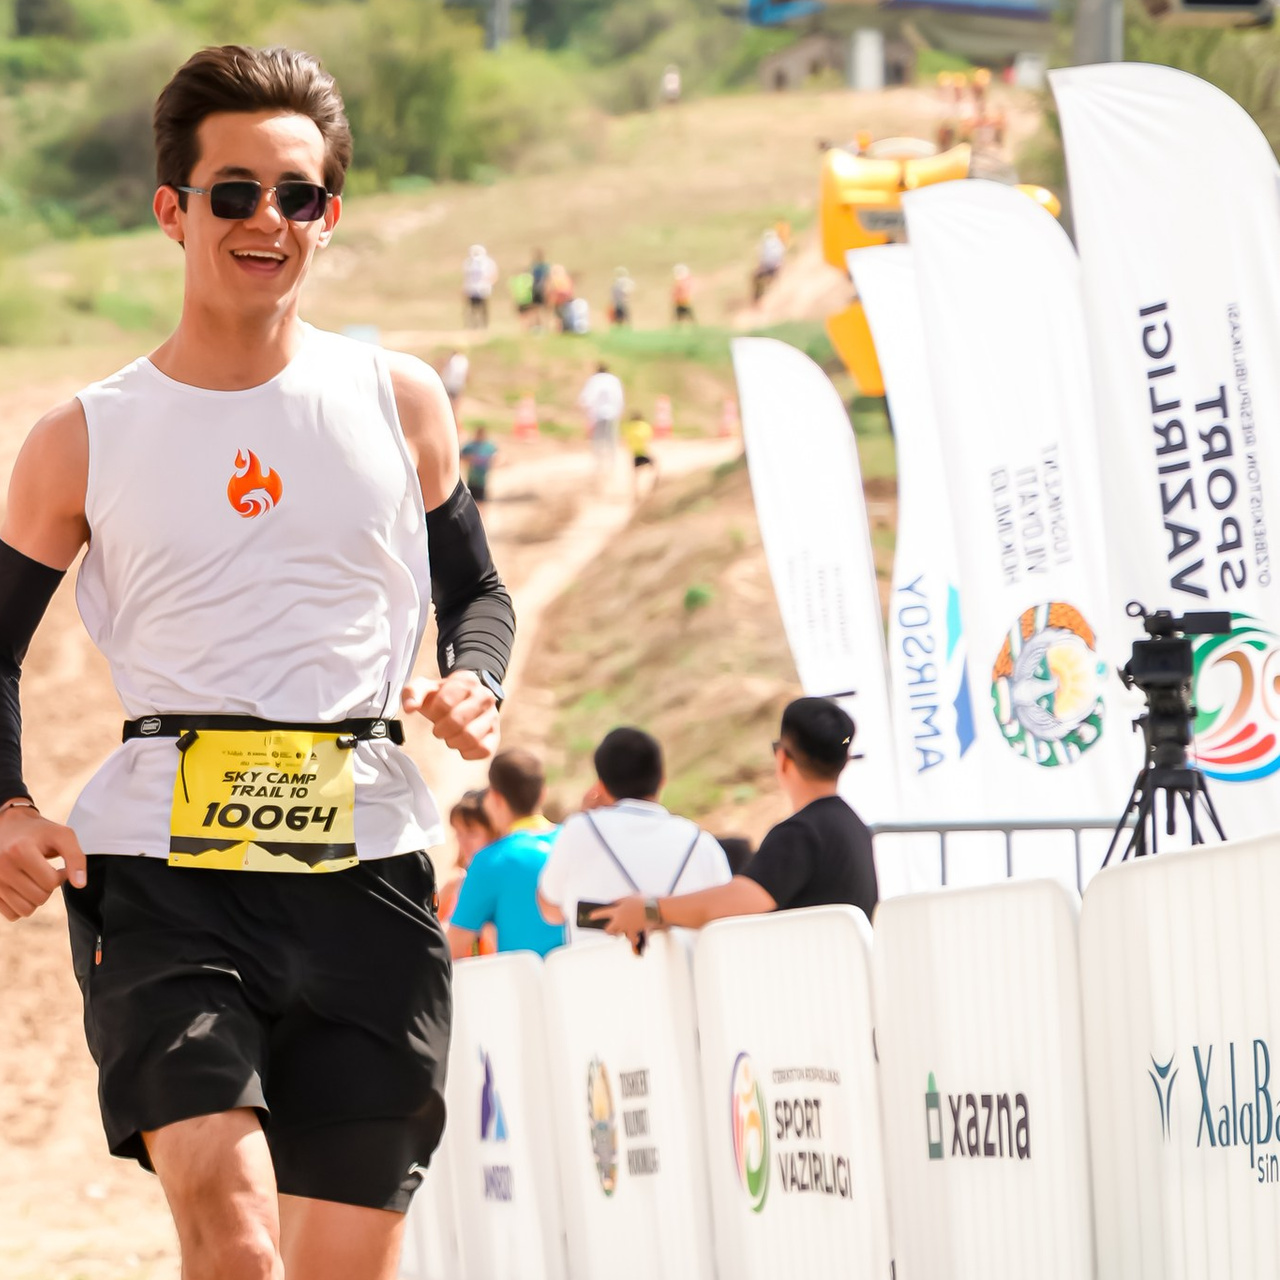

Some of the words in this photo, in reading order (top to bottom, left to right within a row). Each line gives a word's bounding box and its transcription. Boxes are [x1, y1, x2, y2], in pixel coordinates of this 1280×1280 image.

[221, 770, 263, 783] SKY
[265, 772, 318, 786] CAMP
[230, 784, 285, 799] TRAIL
[289, 785, 309, 799] 10
[201, 801, 339, 834] 10064
[774, 1097, 823, 1140] SPORT
[947, 1092, 1032, 1160] xazna
[776, 1150, 854, 1201] VAZIRLIGI
